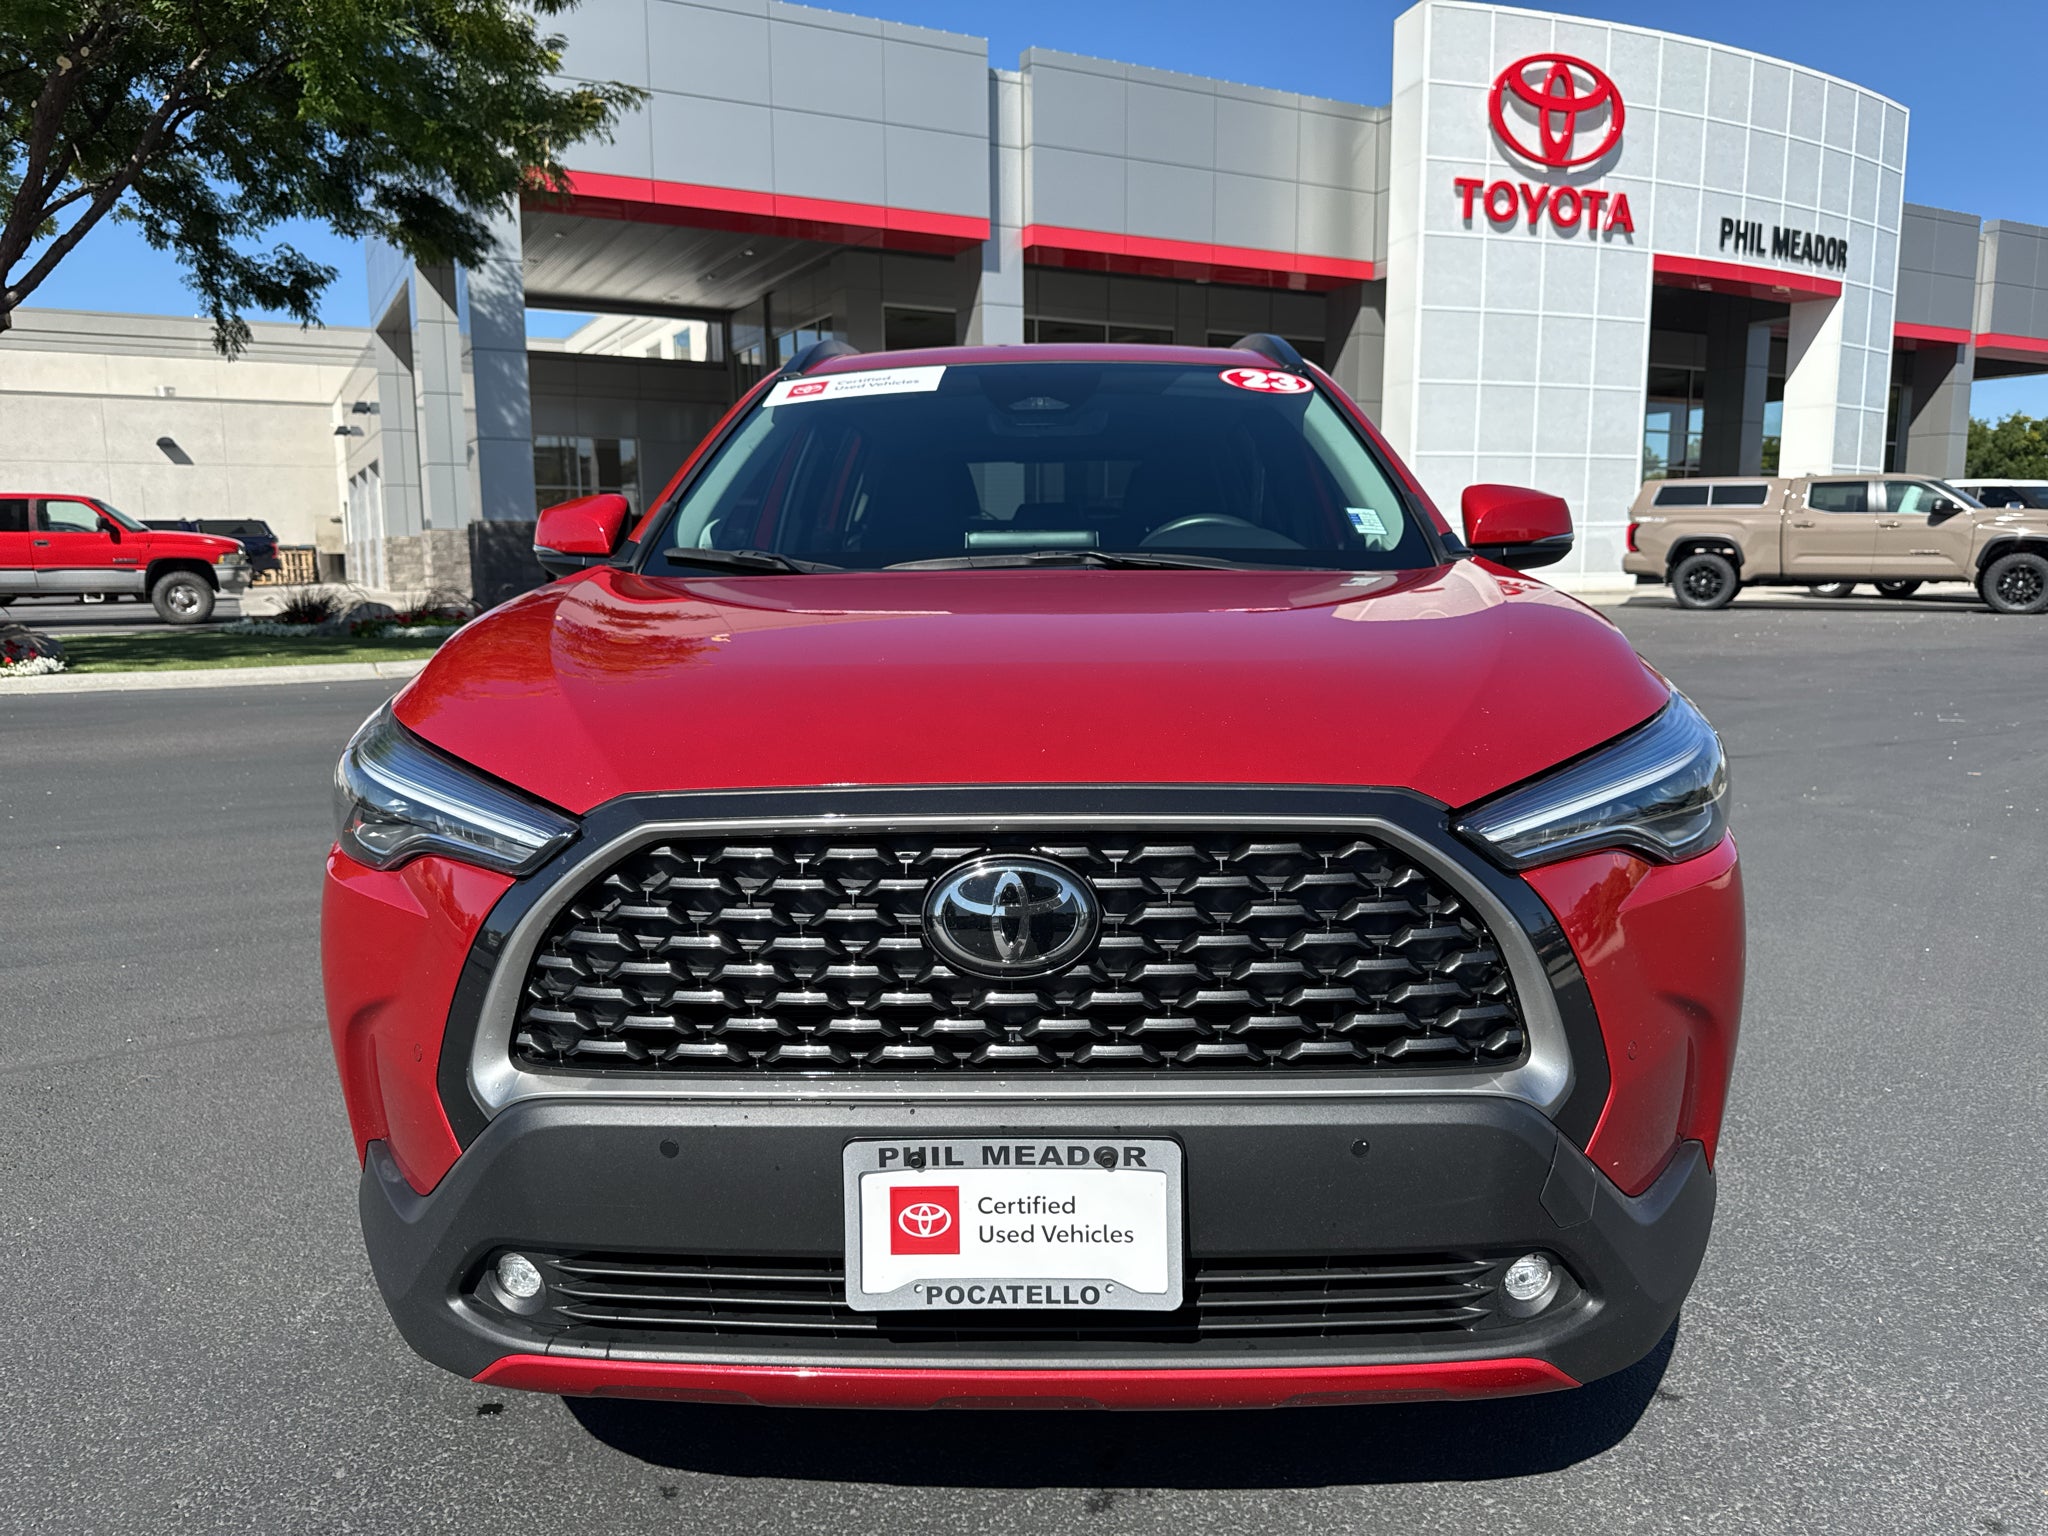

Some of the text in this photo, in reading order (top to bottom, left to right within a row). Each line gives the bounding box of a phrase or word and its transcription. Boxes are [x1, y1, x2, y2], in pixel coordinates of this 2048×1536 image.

[1454, 177, 1635, 233] TOYOTA
[1720, 217, 1848, 272] PHIL MEADOR
[1239, 370, 1300, 391] 23
[878, 1145, 1147, 1168] PHIL MEADOR
[977, 1195, 1076, 1214] Certified
[978, 1224, 1134, 1243] Used Vehicles
[925, 1285, 1101, 1305] POCATELLO
